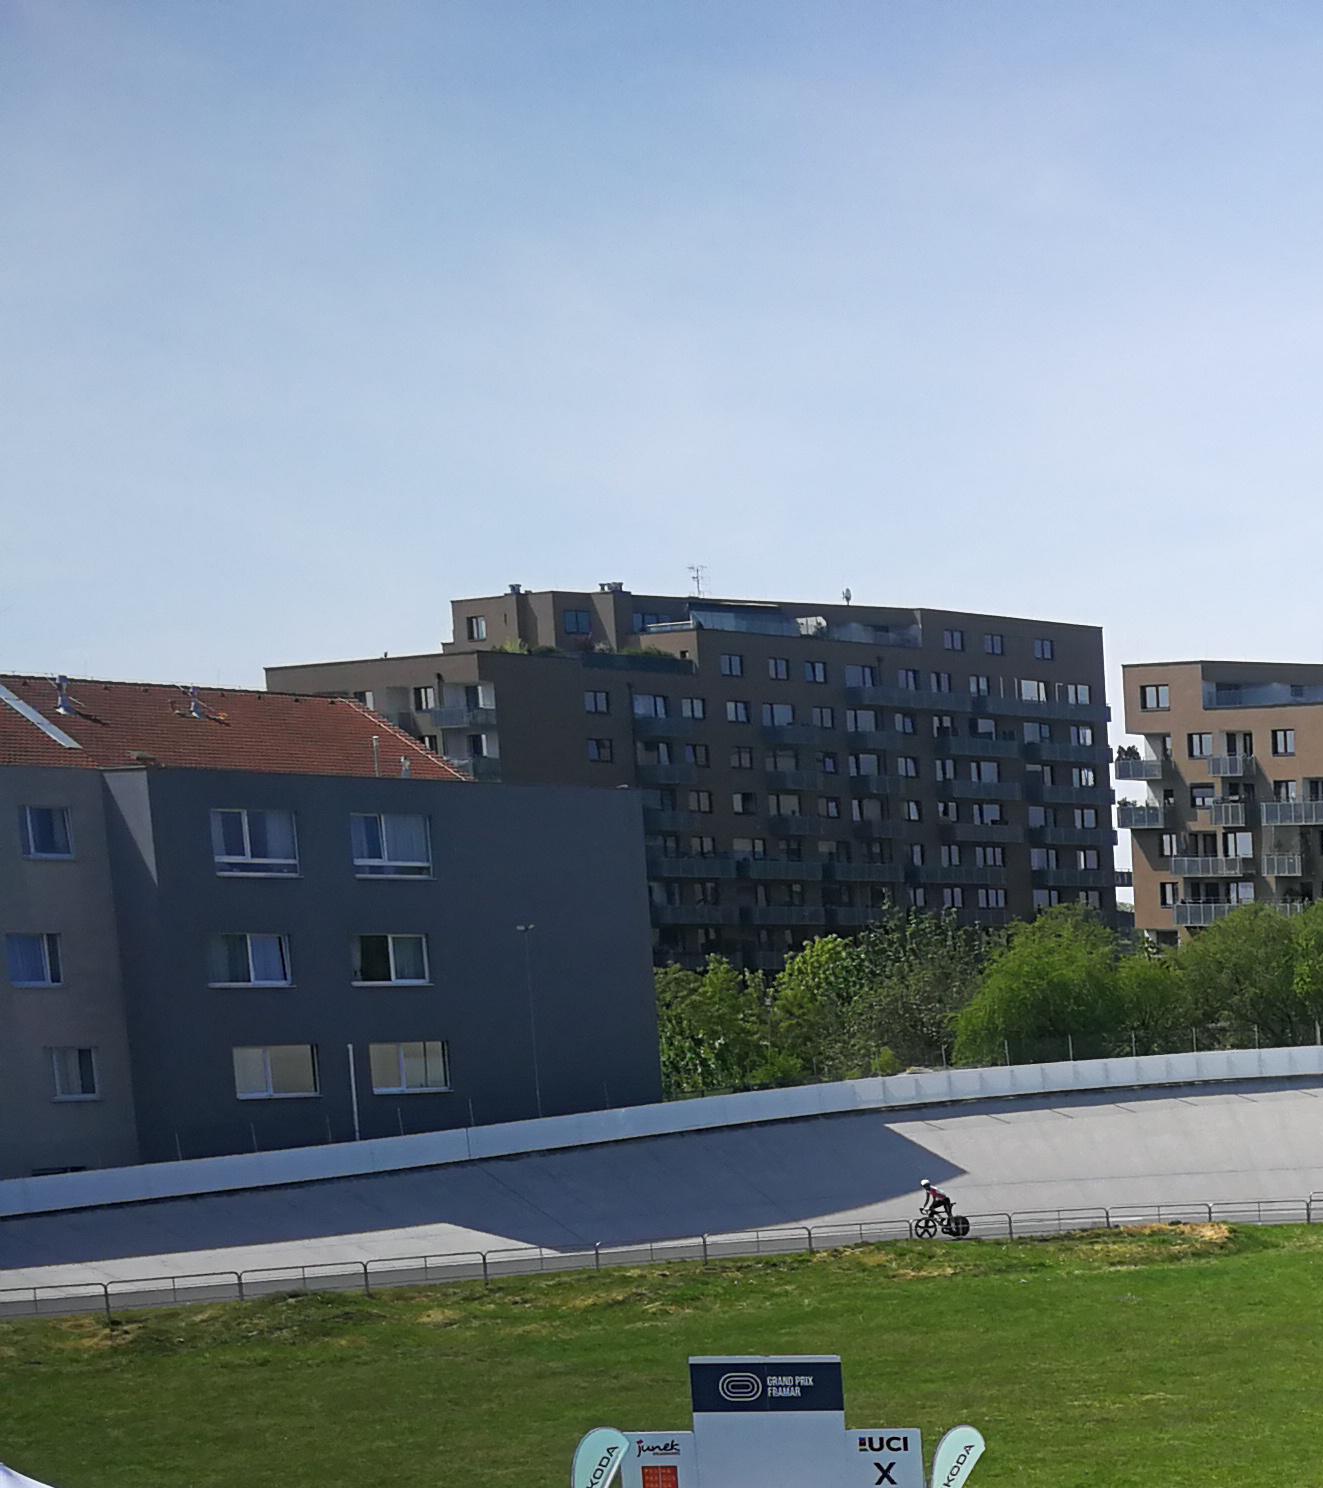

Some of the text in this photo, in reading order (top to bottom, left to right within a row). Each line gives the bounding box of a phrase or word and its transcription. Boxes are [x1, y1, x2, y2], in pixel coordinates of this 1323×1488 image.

[766, 1376, 813, 1386] GRAND PRIX
[768, 1387, 801, 1397] FRAMAR
[637, 1439, 680, 1457] junek
[868, 1437, 909, 1452] UCI
